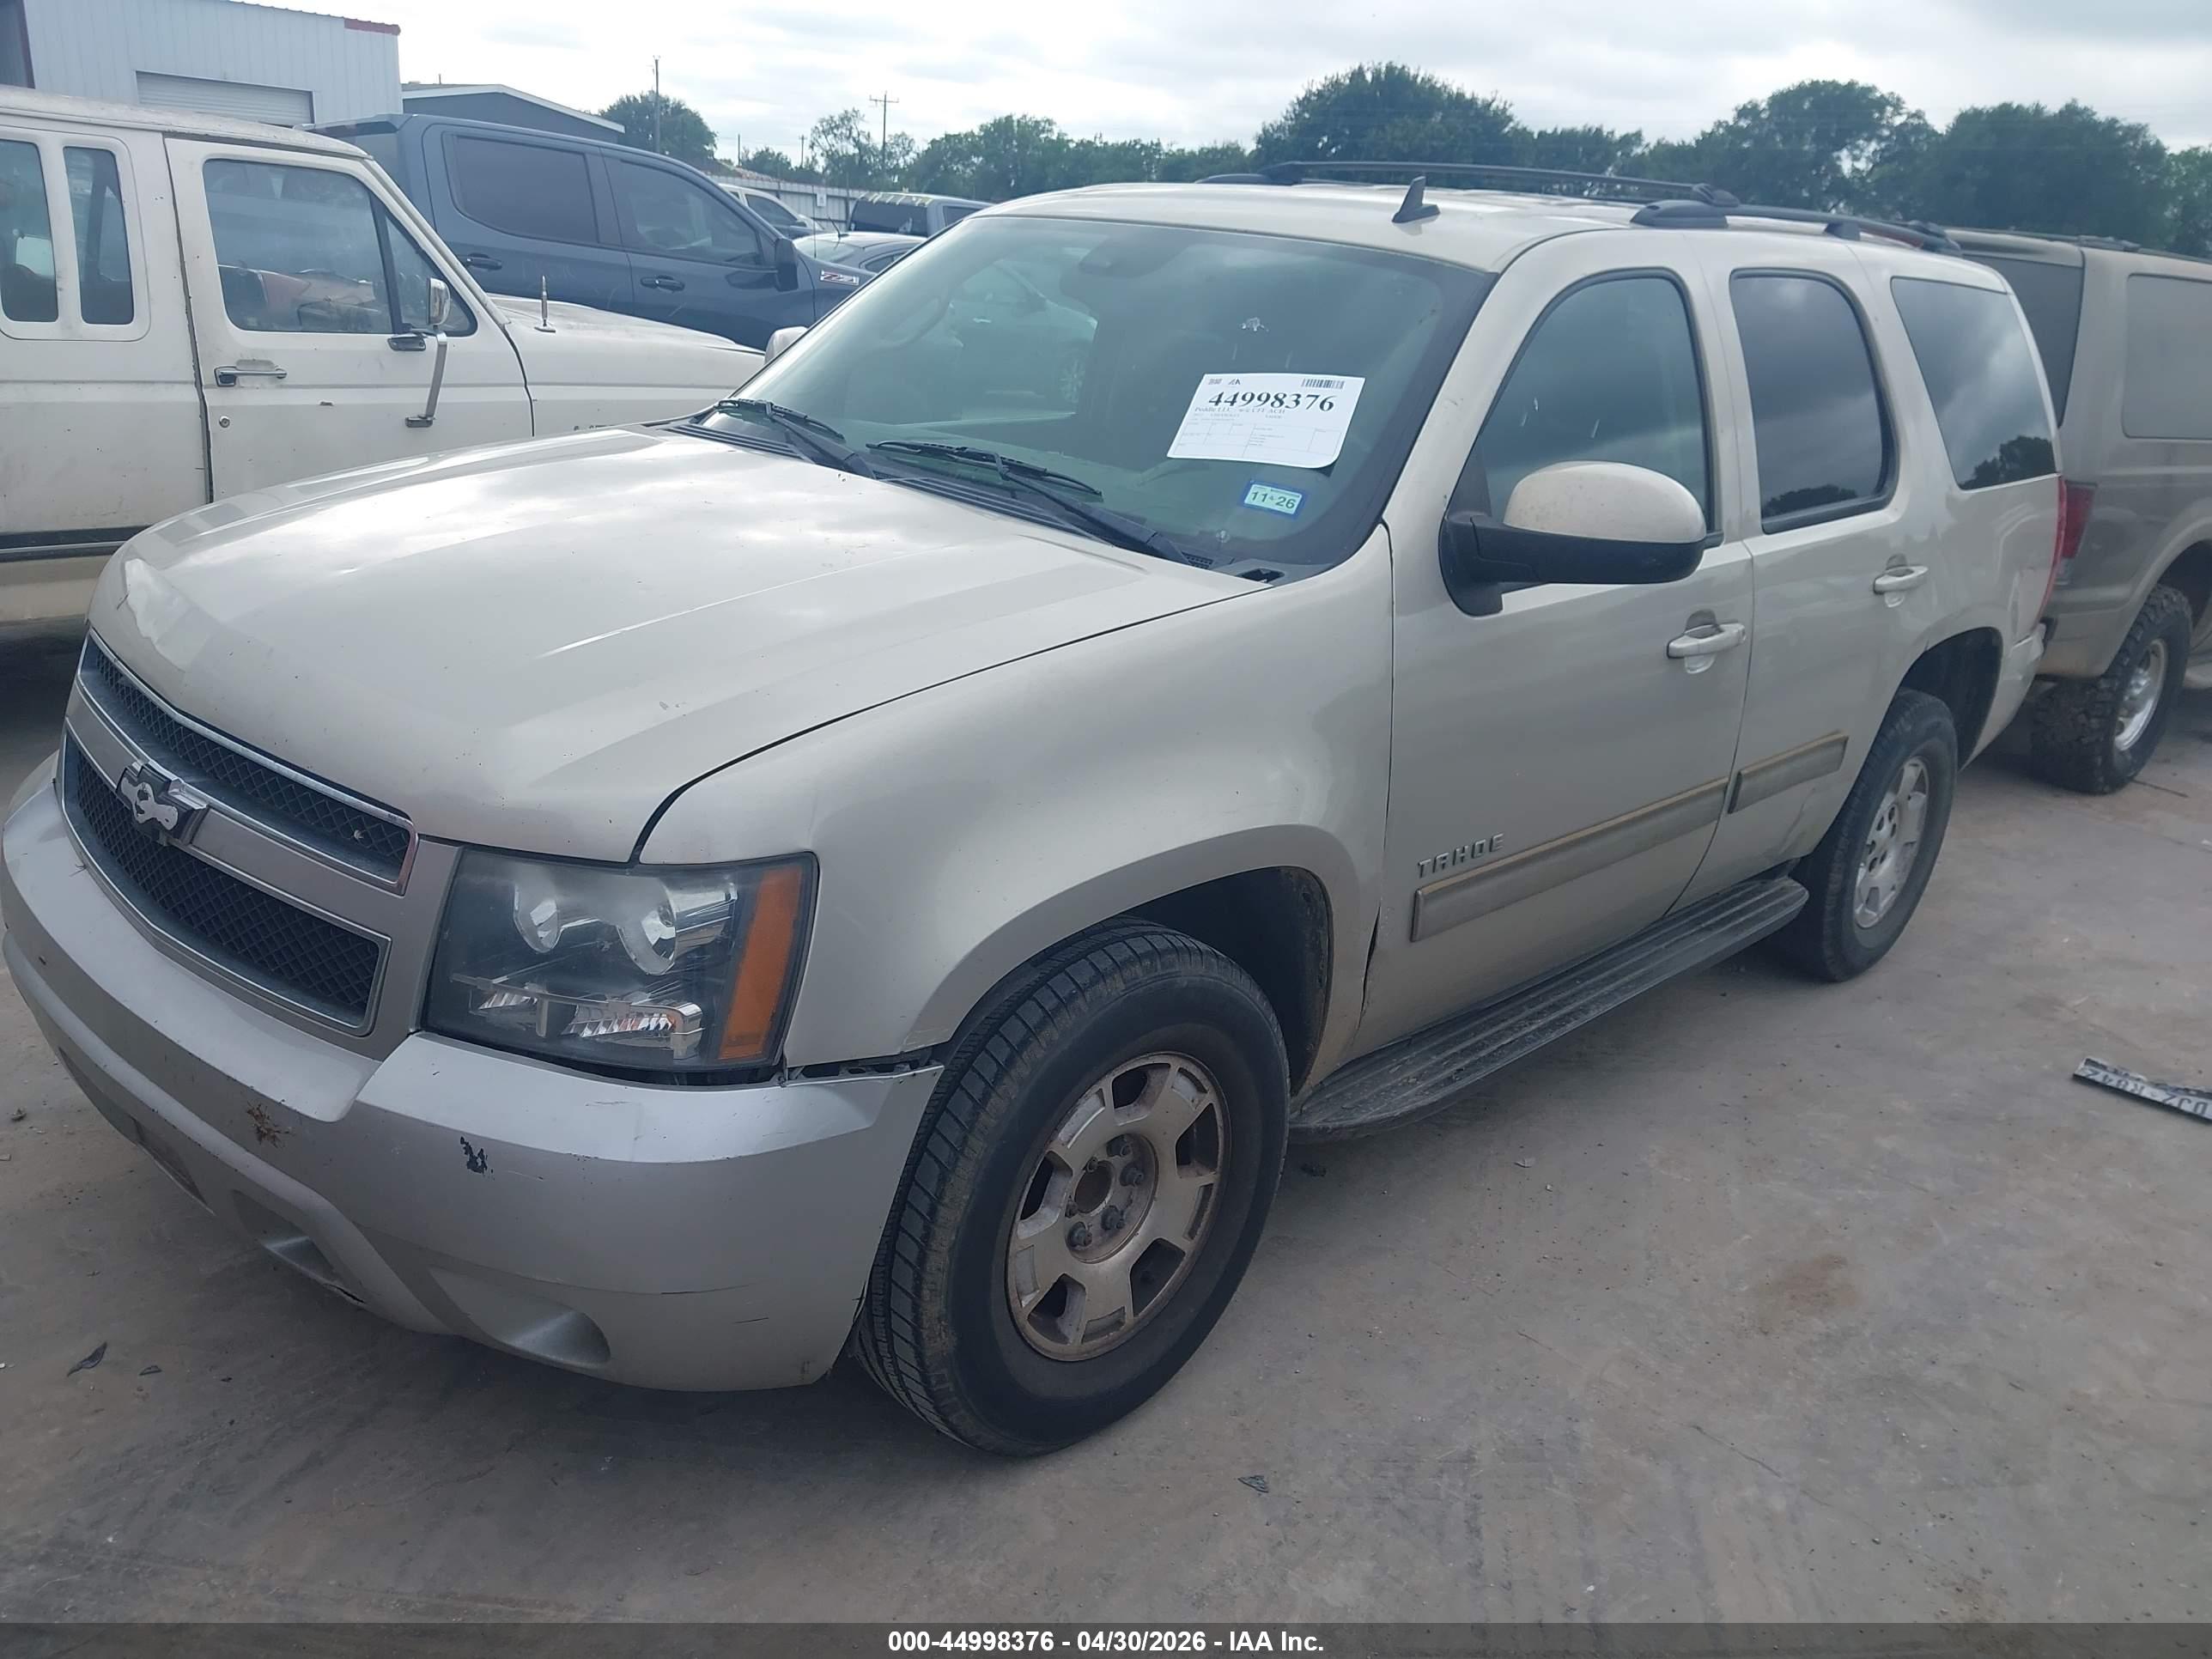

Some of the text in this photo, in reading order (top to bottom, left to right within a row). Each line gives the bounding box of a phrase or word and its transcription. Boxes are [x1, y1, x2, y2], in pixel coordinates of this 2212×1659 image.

[1208, 392, 1337, 412] 44998376
[1251, 490, 1268, 502] 11
[1275, 495, 1297, 509] 26
[1417, 833, 1504, 878] TAHOE
